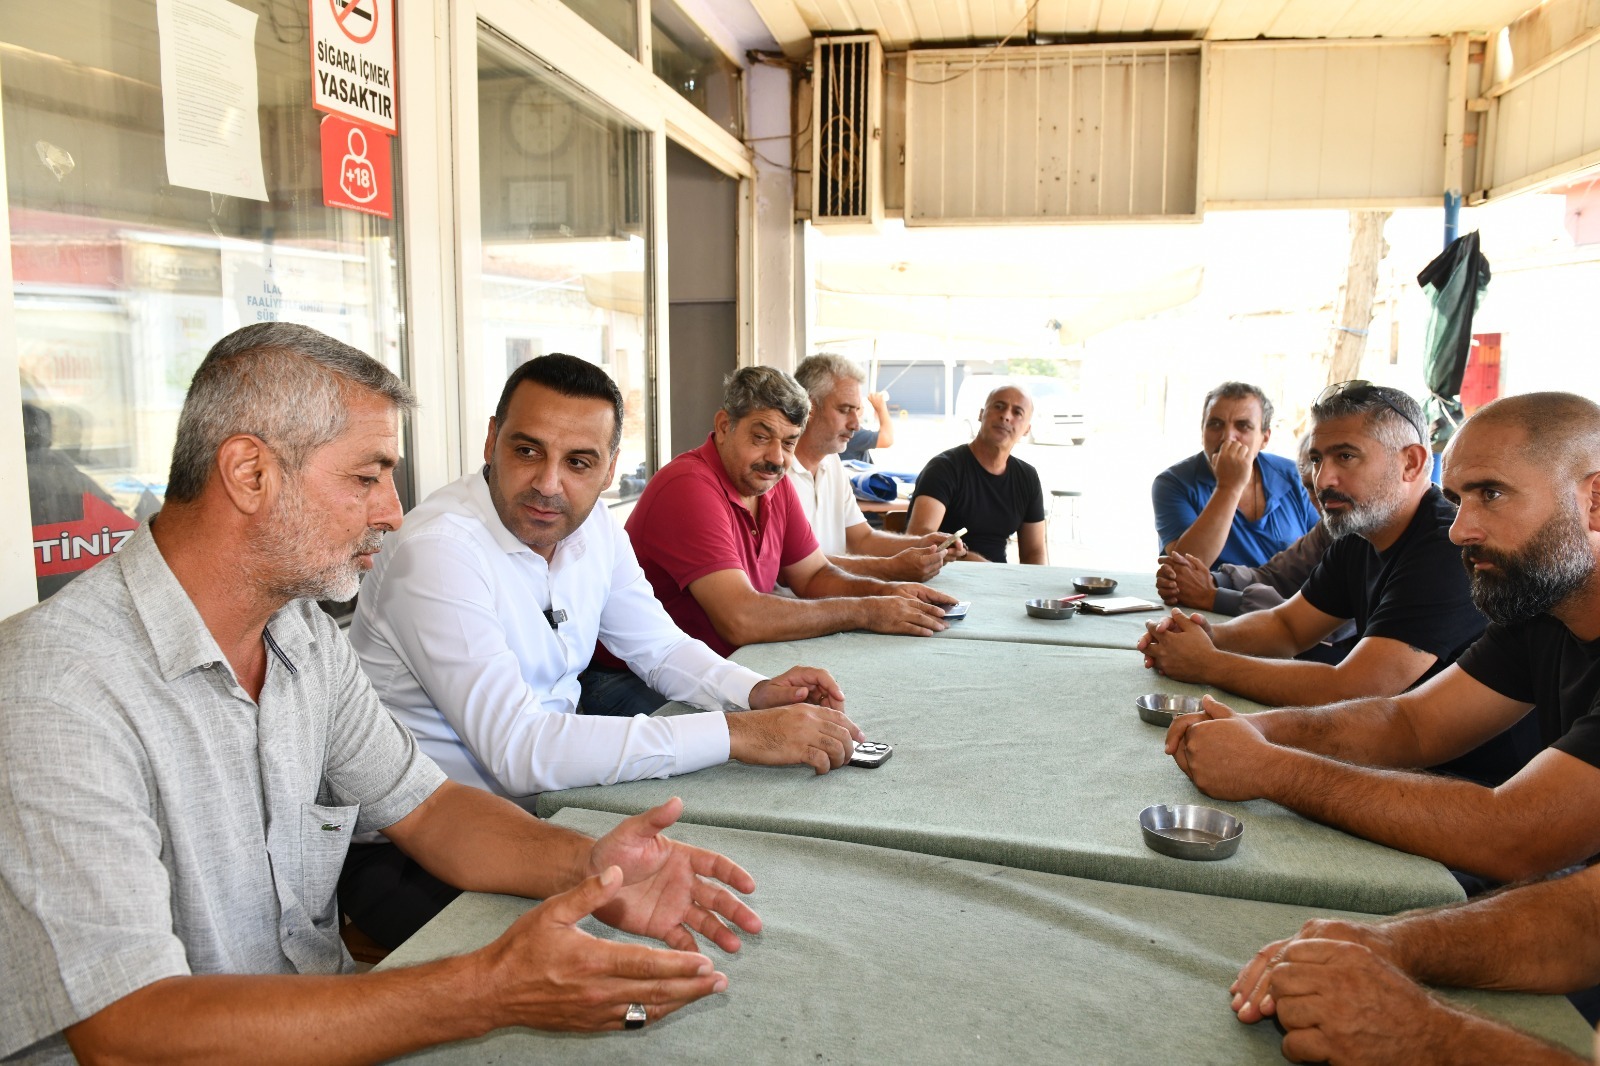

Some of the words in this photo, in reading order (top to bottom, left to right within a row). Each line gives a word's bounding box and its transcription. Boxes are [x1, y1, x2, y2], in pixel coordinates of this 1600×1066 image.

[318, 38, 357, 75] SİGARA
[360, 53, 390, 88] İÇMEK
[318, 70, 392, 119] YASAKTIR
[346, 167, 370, 188] +18
